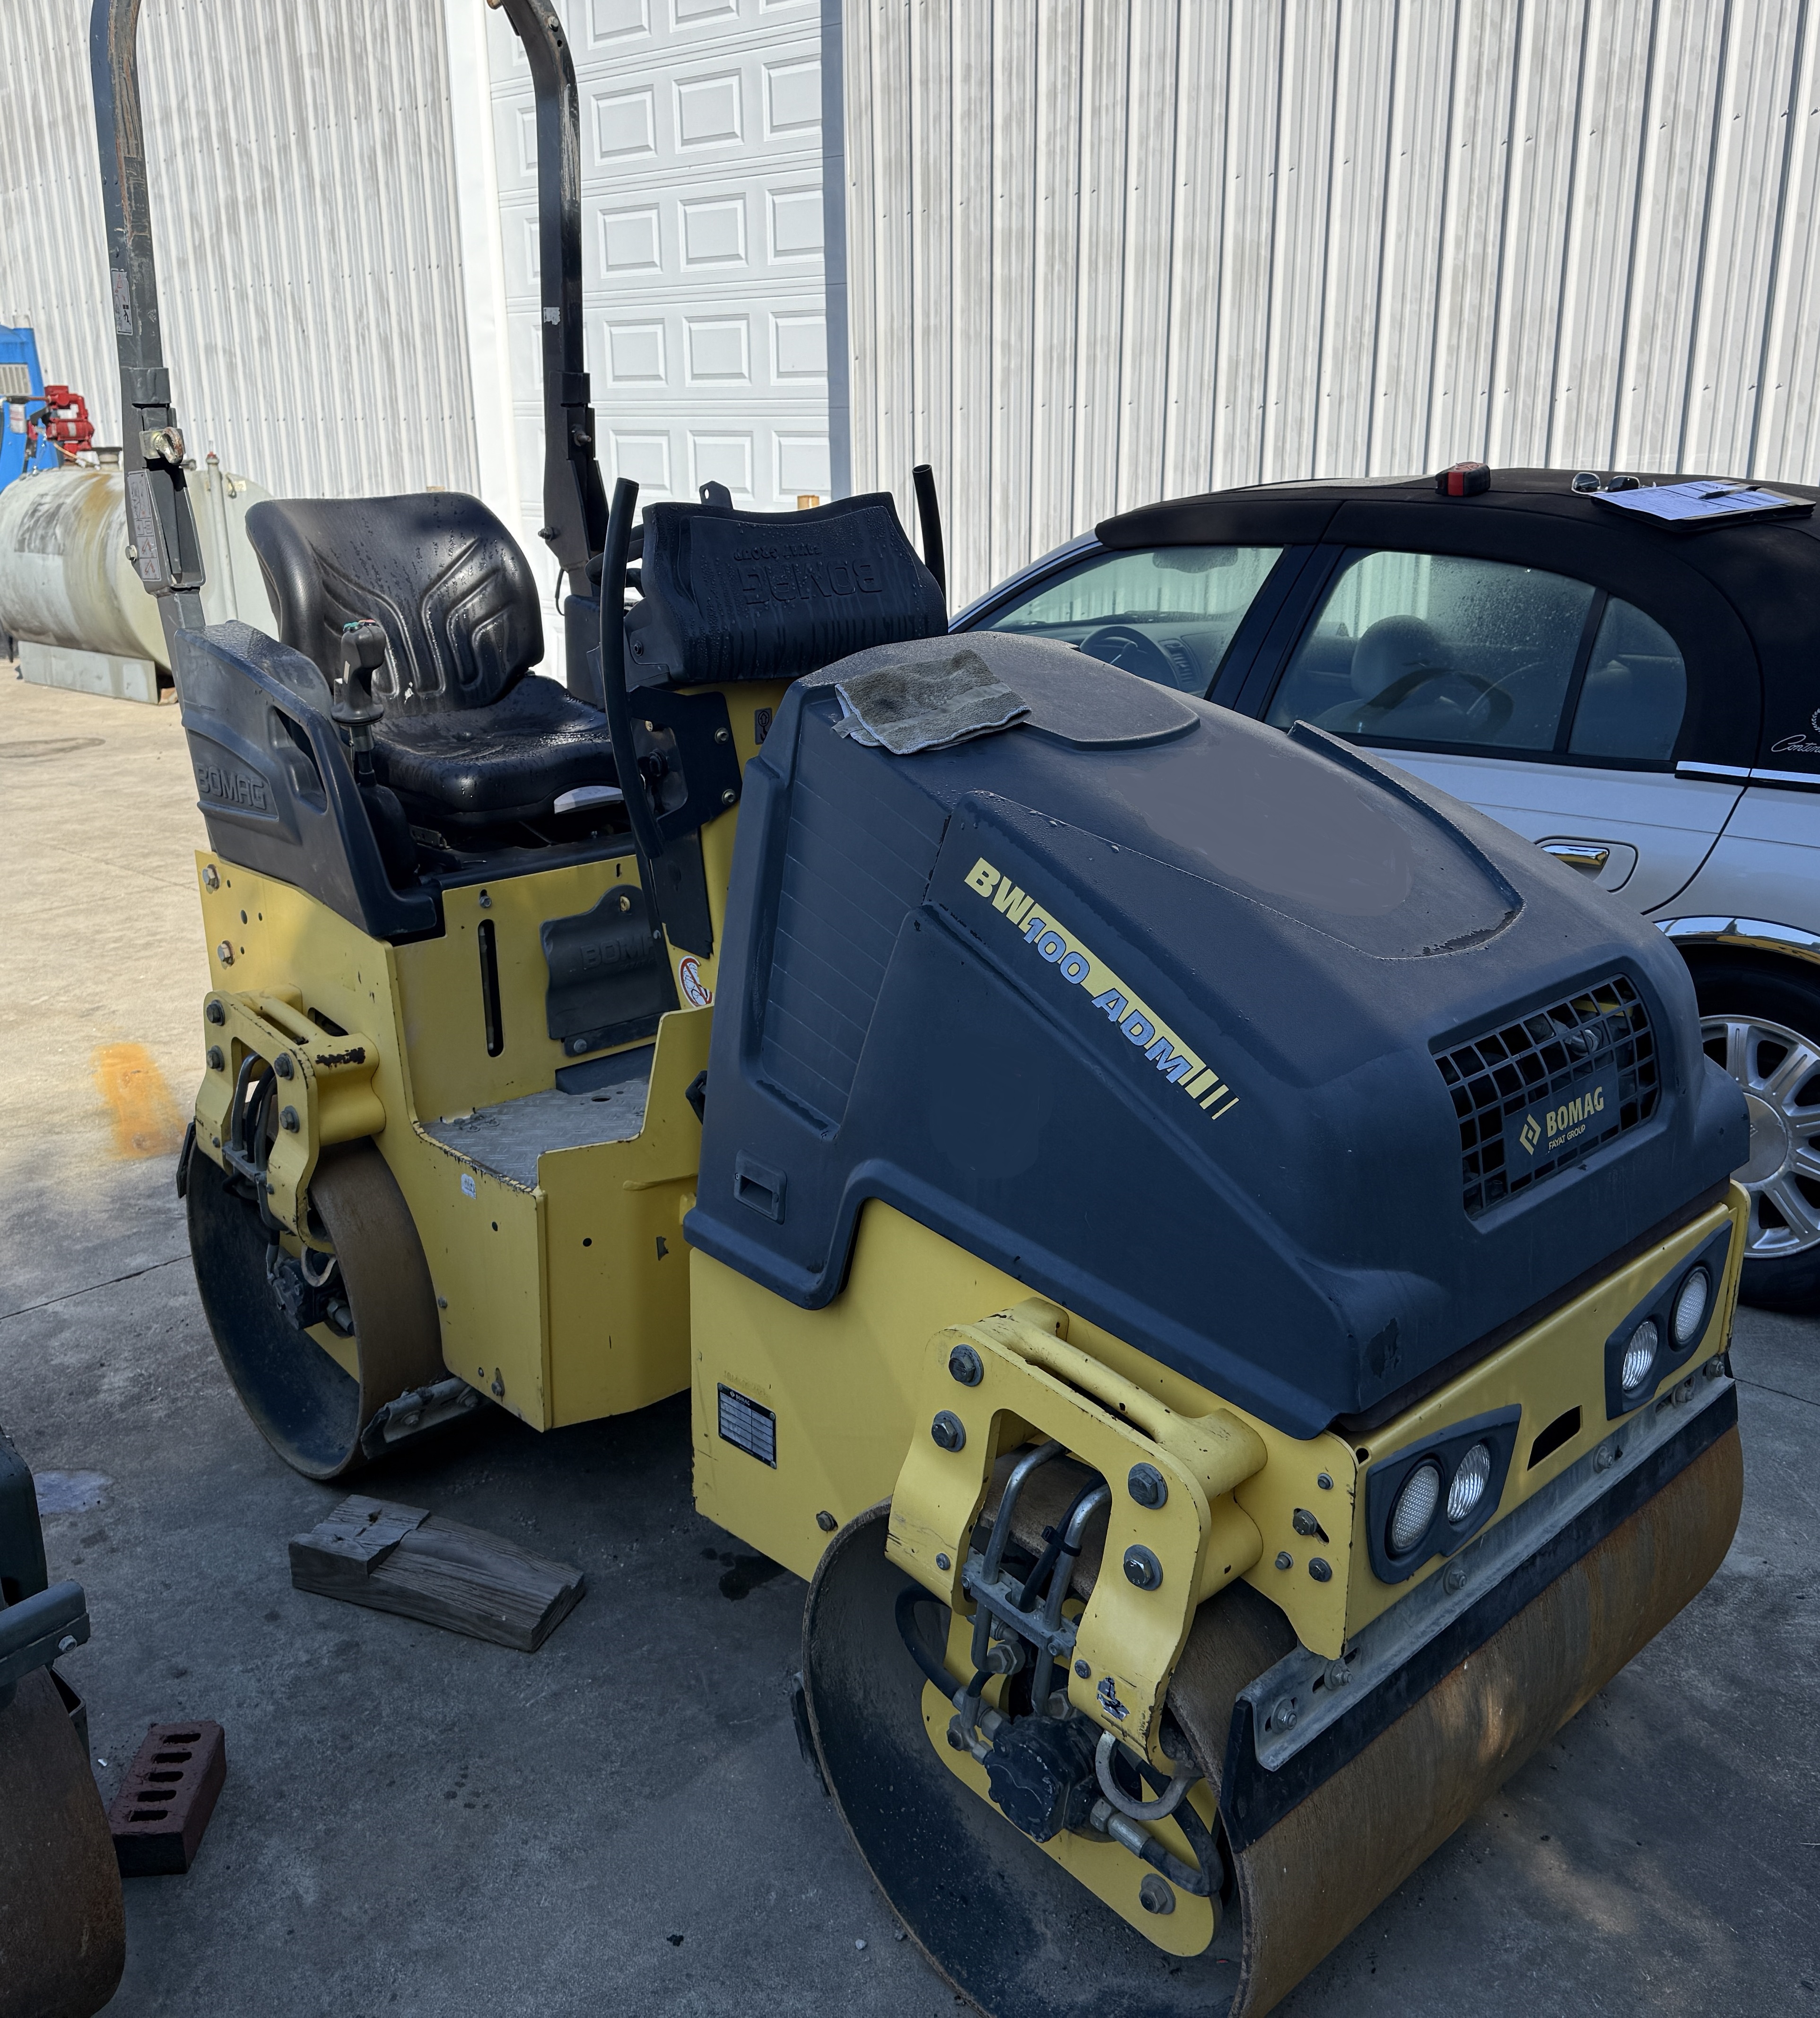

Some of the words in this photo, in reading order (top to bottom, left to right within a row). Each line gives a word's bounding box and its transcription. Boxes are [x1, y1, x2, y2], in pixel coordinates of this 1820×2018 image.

[736, 559, 883, 605] BOMAG
[1771, 734, 1820, 753] Contin
[195, 762, 267, 810] BOMAG
[1090, 987, 1193, 1083] ADM
[1546, 1086, 1604, 1137] BOMAG
[1549, 1135, 1566, 1150] FAYAT
[1567, 1124, 1585, 1140] GROUP
